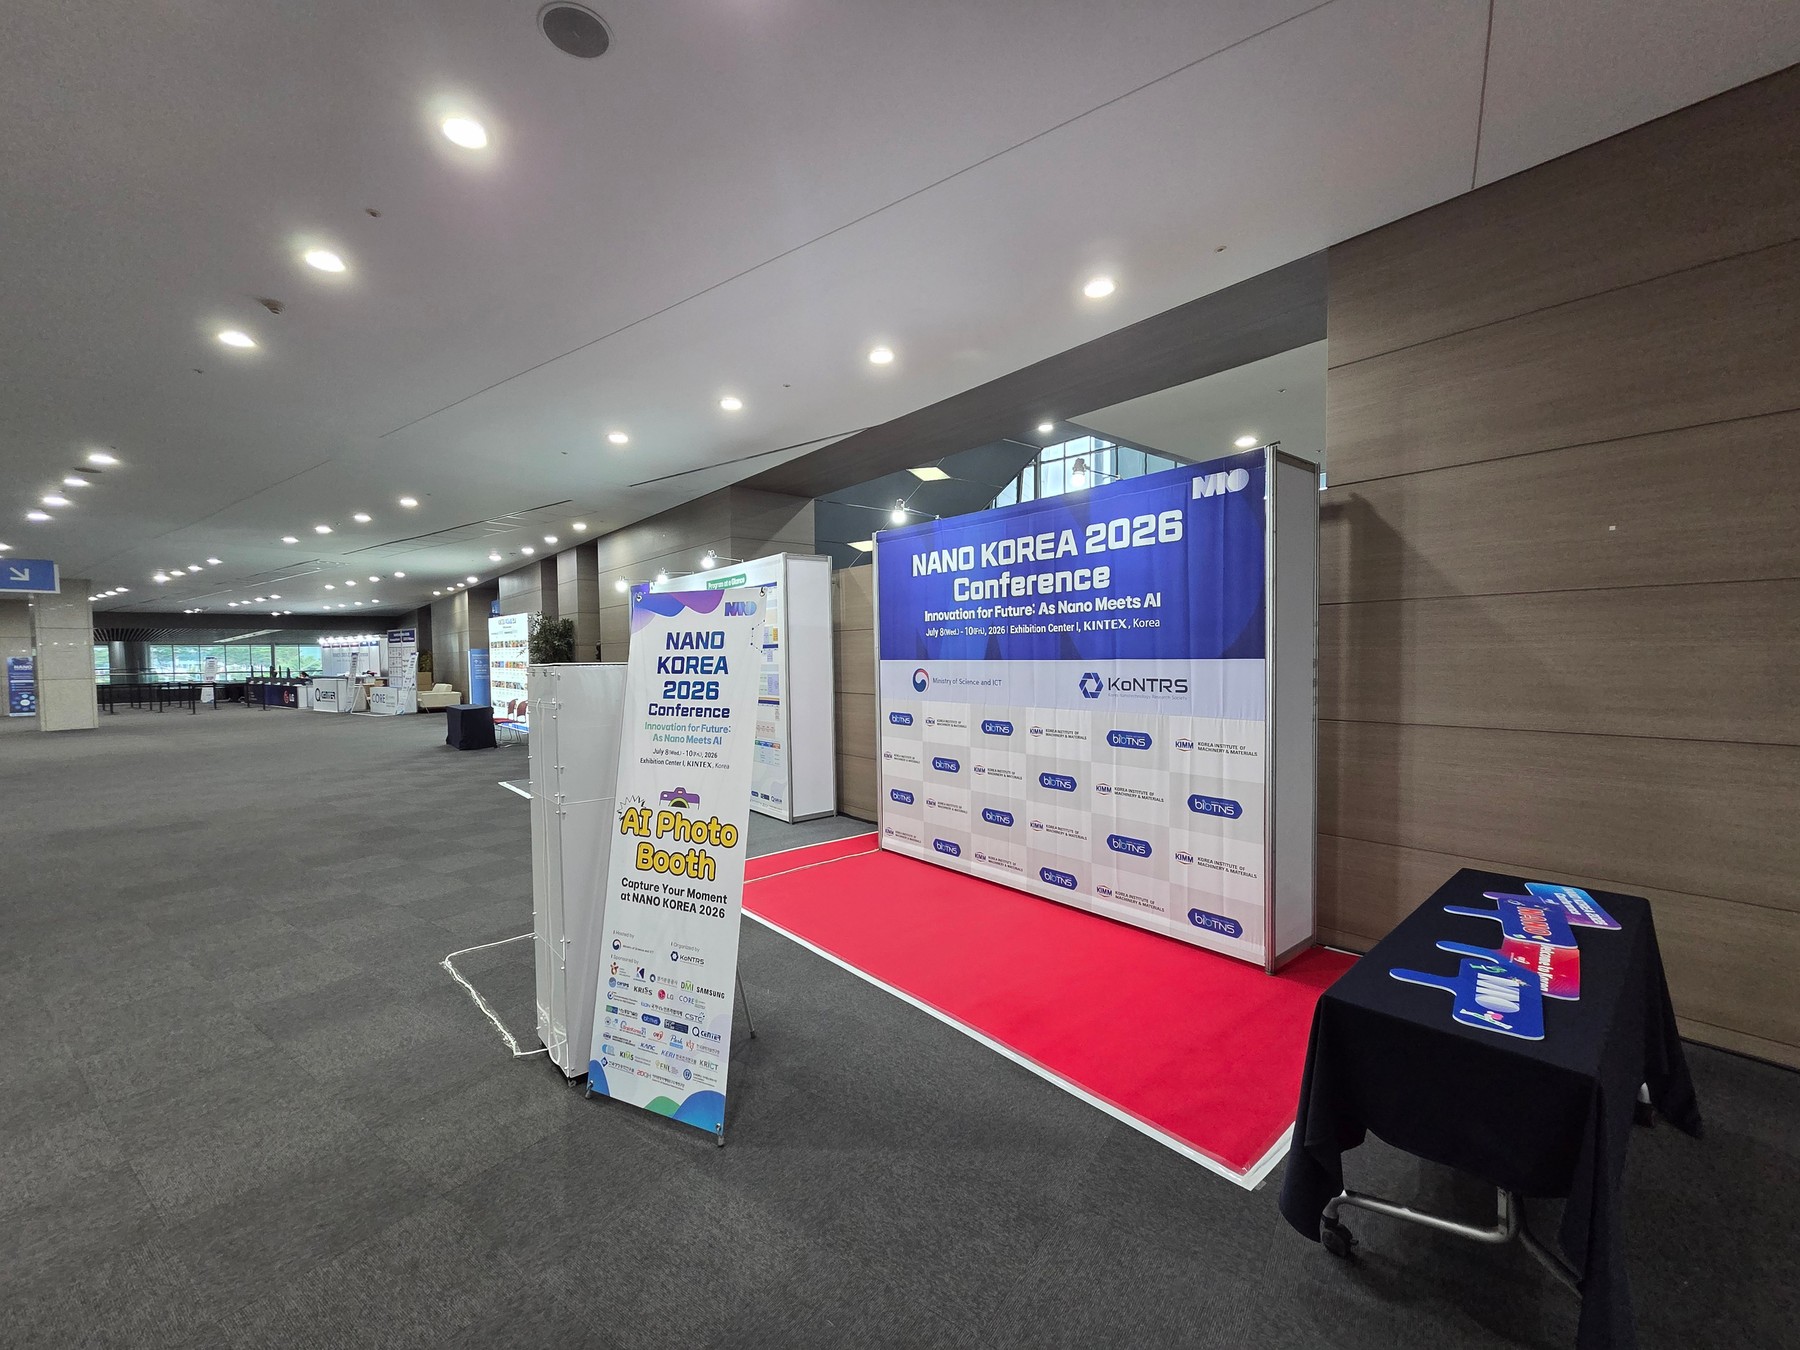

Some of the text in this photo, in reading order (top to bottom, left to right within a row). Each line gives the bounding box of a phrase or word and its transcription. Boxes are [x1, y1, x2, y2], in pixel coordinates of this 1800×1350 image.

[912, 509, 1183, 577] NANO KOREA 2026
[953, 565, 1110, 602] Conference
[924, 592, 1161, 622] Innovation for Future: As Nano Meets AI
[925, 628, 939, 637] July
[988, 626, 1006, 635] 2026
[1010, 624, 1046, 635] Exhibition
[1047, 622, 1075, 633] Center
[1132, 617, 1160, 629] Korea
[666, 631, 725, 650] NANO
[657, 656, 729, 675] KOREA
[663, 681, 719, 700] 2026
[1108, 677, 1188, 694] KoNTRS
[648, 703, 730, 718] Conference
[644, 721, 731, 734] Innovation for Future:
[652, 733, 723, 745] As Nano Meets AI
[1175, 740, 1194, 749] KIMM
[653, 748, 664, 757] July
[704, 751, 718, 759] 2026
[1198, 746, 1225, 754] MACHINERY
[640, 757, 664, 766] Exhibition
[665, 759, 681, 767] Center
[1096, 785, 1112, 793] KIMM
[620, 807, 739, 848] AI Photo
[636, 842, 716, 882] Booth
[1175, 853, 1194, 863] KIMM
[621, 877, 728, 905] Capture Your Moment
[1096, 886, 1113, 896] KIMM
[620, 892, 726, 919] at NANO KOREA 2026
[633, 985, 653, 996] KRISS
[667, 993, 674, 1001] LG
[696, 986, 725, 999] SAMSUNG
